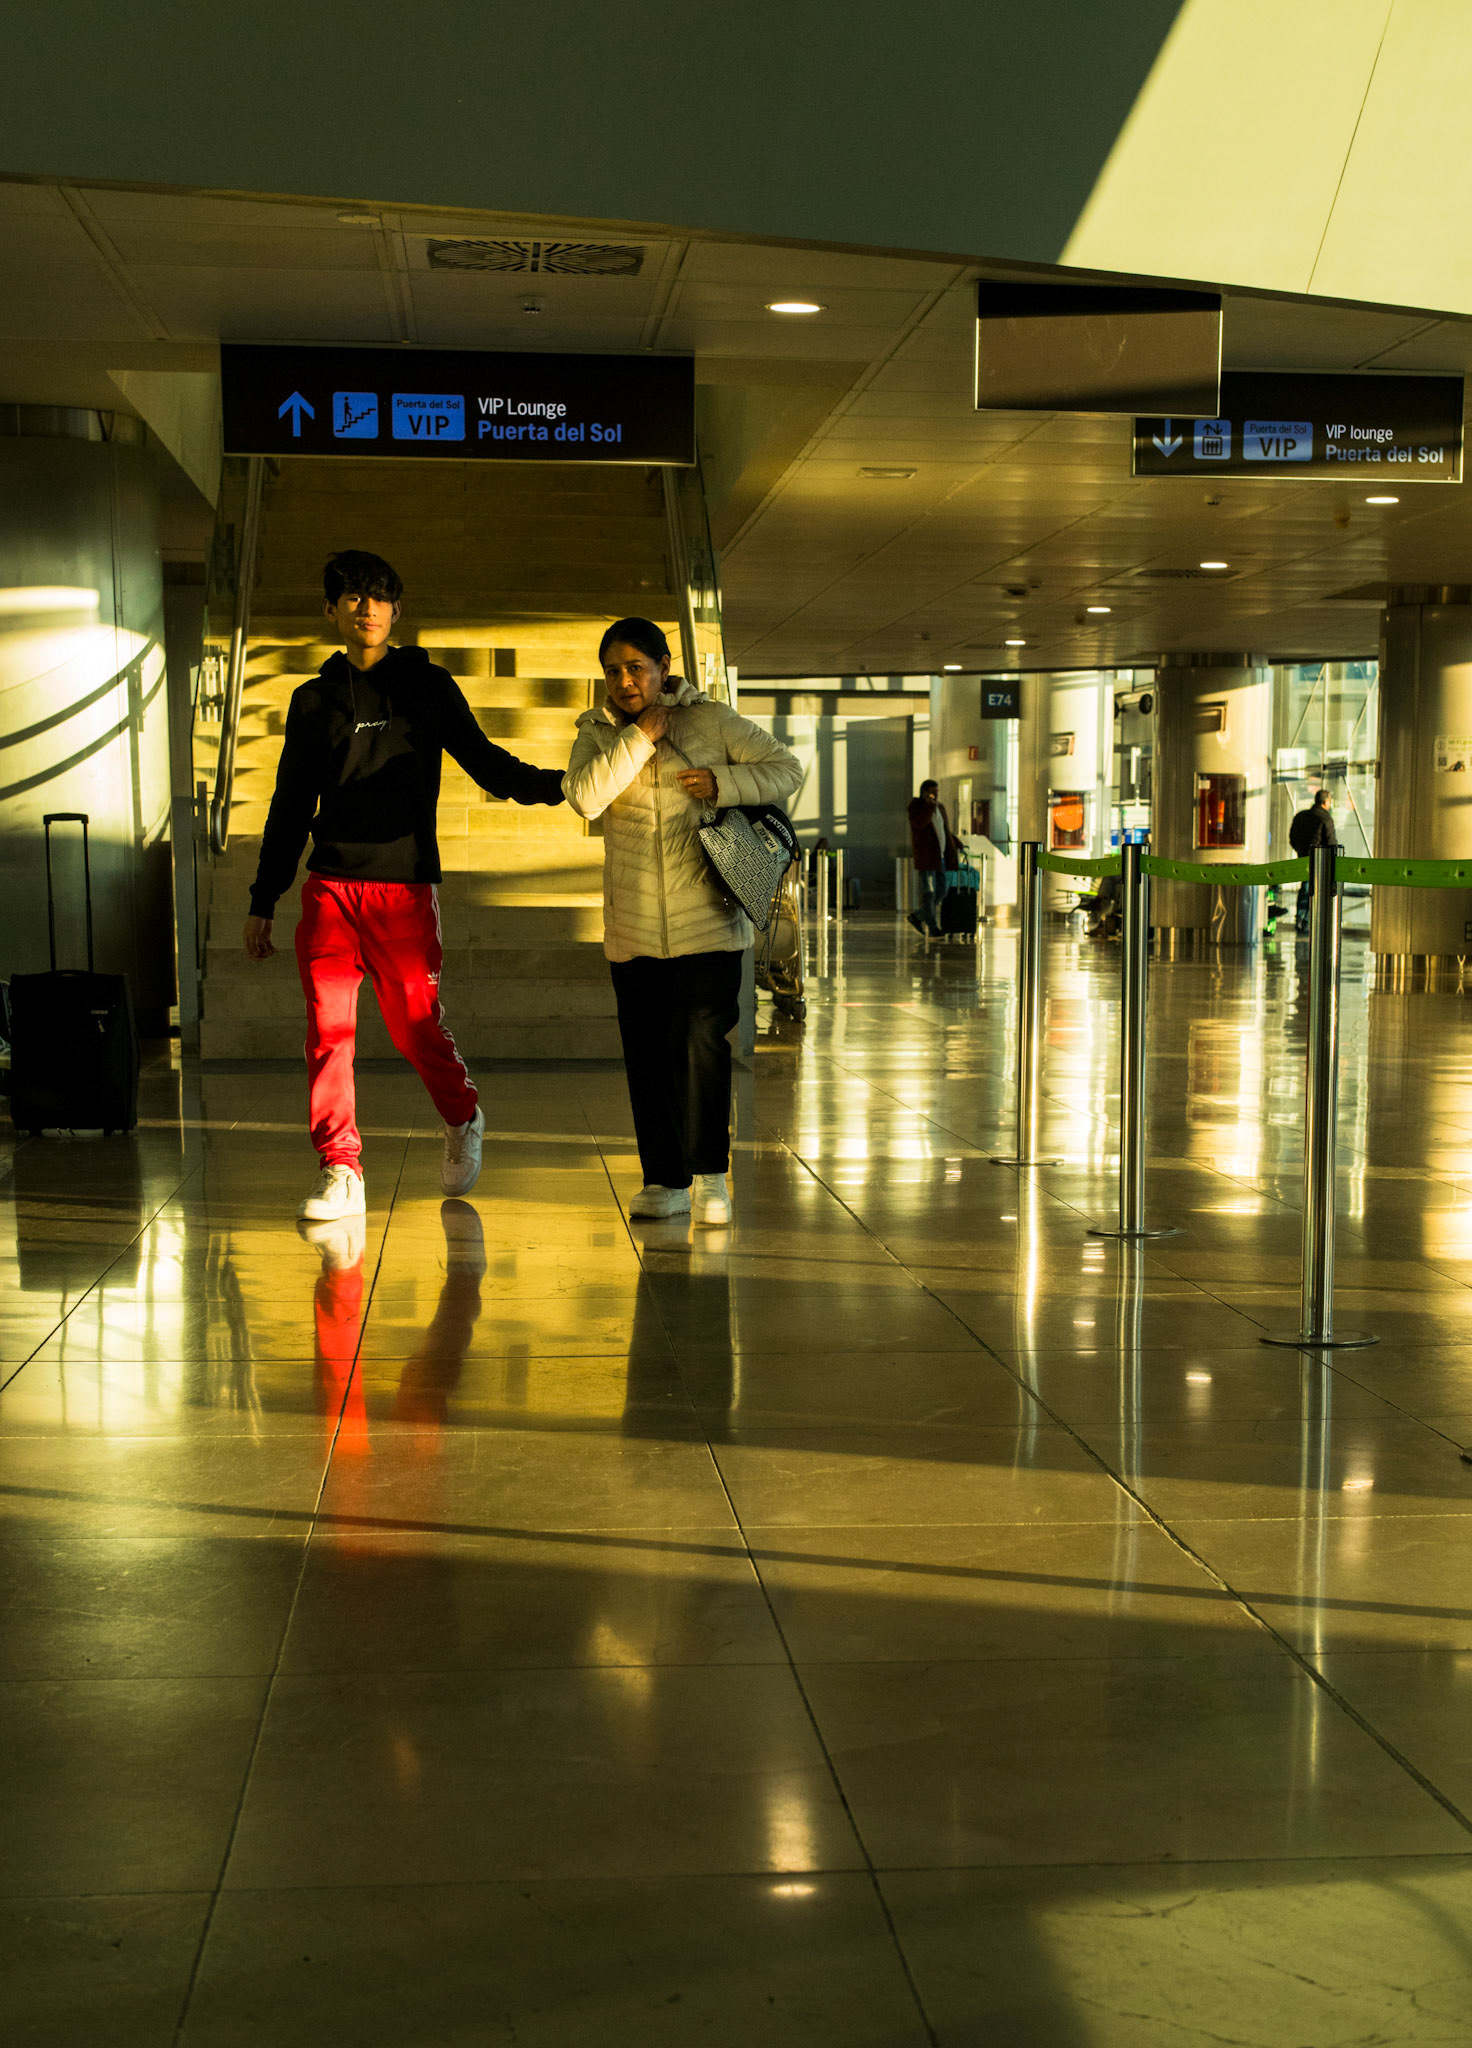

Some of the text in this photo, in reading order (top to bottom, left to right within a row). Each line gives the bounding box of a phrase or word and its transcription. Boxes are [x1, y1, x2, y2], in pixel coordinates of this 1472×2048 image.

[397, 399, 460, 410] Puerta del Sol
[478, 397, 567, 420] VIP Lounge
[408, 414, 449, 436] VIP
[478, 420, 622, 443] Puerta del Sol
[1249, 423, 1307, 435] Puerta del Sol
[1325, 424, 1394, 443] VIP lounge
[1259, 437, 1297, 457] VIP
[1325, 444, 1444, 464] Puerta del Sol
[988, 693, 1011, 706] E74
[354, 719, 388, 733] pray
